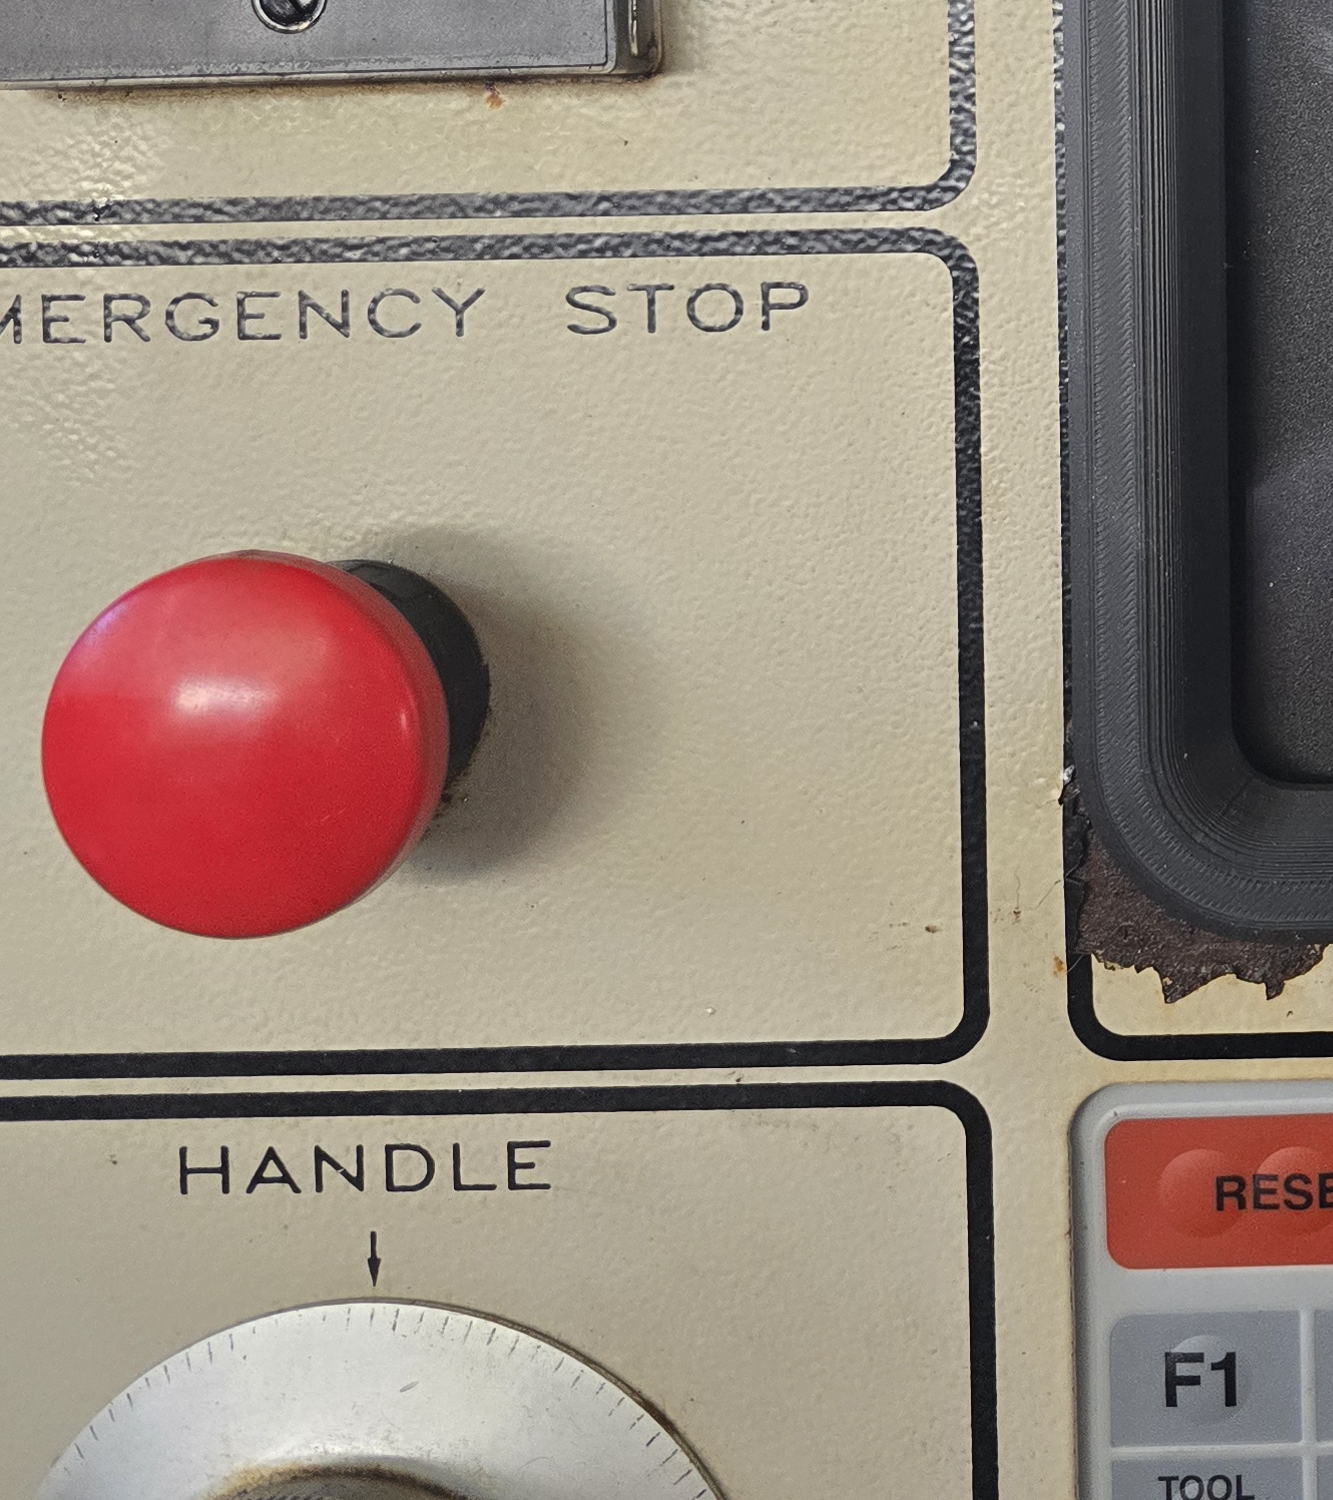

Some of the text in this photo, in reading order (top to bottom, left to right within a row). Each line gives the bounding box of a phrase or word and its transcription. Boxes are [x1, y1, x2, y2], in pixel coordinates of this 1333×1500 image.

[565, 281, 811, 336] STOP
[178, 1140, 552, 1195] HANDLE
[1164, 1351, 1239, 1408] F1
[1158, 1474, 1255, 1500] TOOL
